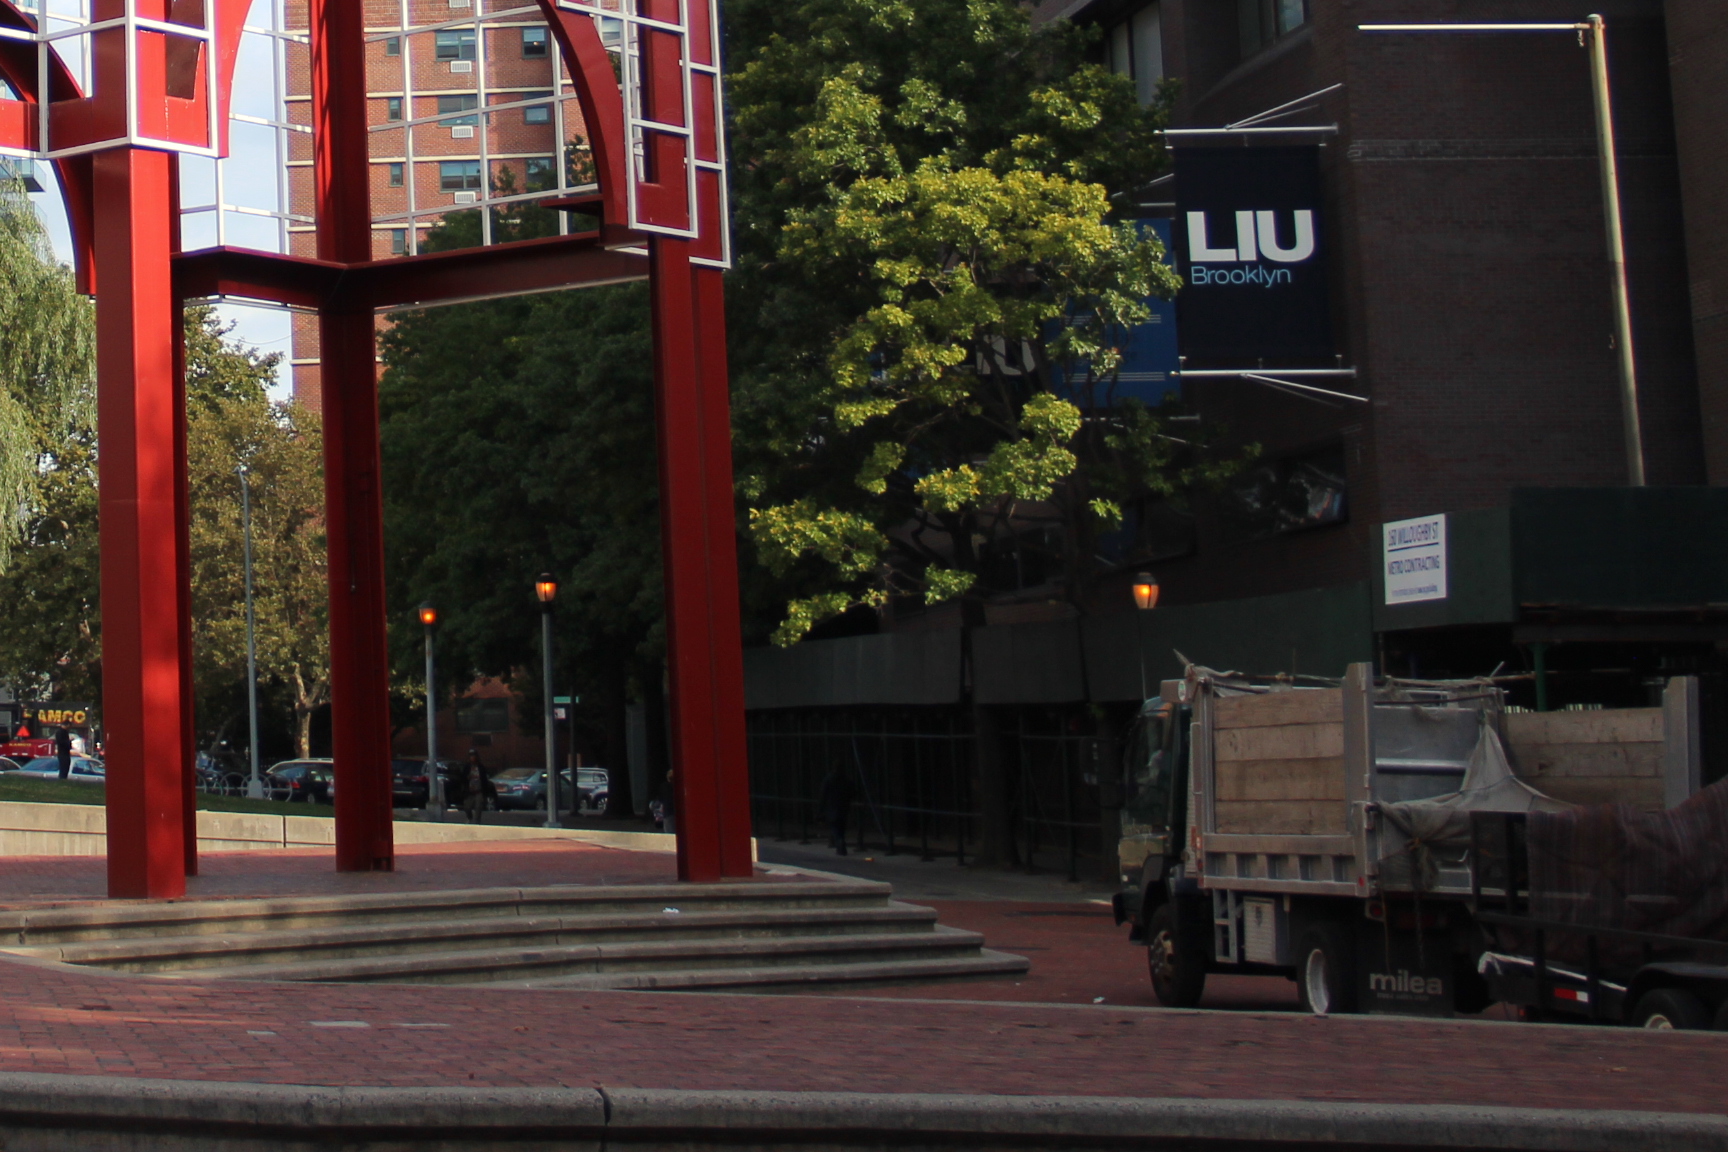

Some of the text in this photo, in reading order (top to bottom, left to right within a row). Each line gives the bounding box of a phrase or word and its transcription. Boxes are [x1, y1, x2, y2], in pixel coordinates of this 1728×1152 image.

[1186, 209, 1315, 262] LIU
[1191, 265, 1291, 288] Brooklyn
[1398, 523, 1432, 545] WILLOUGHBY
[1388, 555, 1440, 575] METRO CONTRACTING
[1369, 969, 1443, 995] milea
